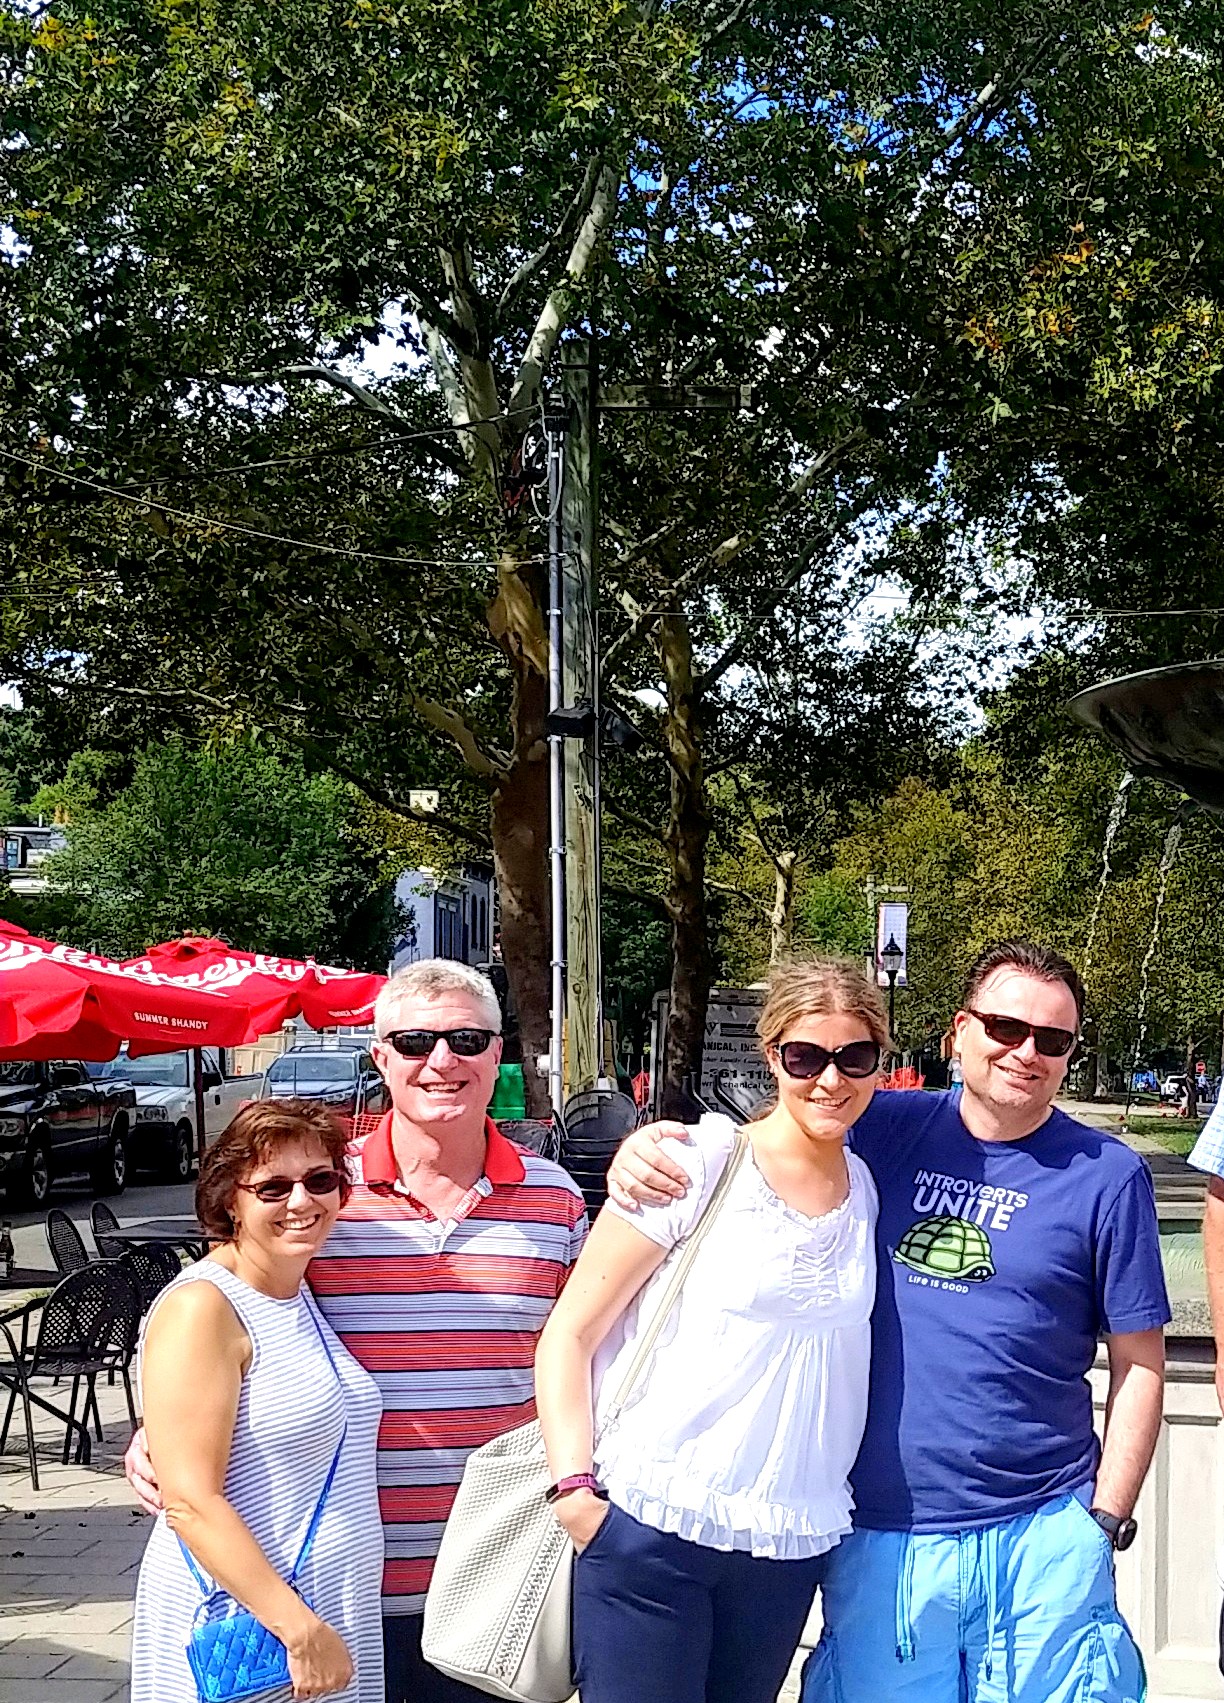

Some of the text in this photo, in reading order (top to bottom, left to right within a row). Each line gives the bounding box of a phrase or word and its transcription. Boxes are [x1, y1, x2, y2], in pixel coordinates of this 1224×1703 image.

[134, 1011, 209, 1030] SUMMER SHANDY
[914, 1169, 1029, 1208] INTROVeRTS
[913, 1185, 1015, 1231] UNITE
[930, 1279, 940, 1288] IS
[941, 1281, 969, 1294] GOOD
